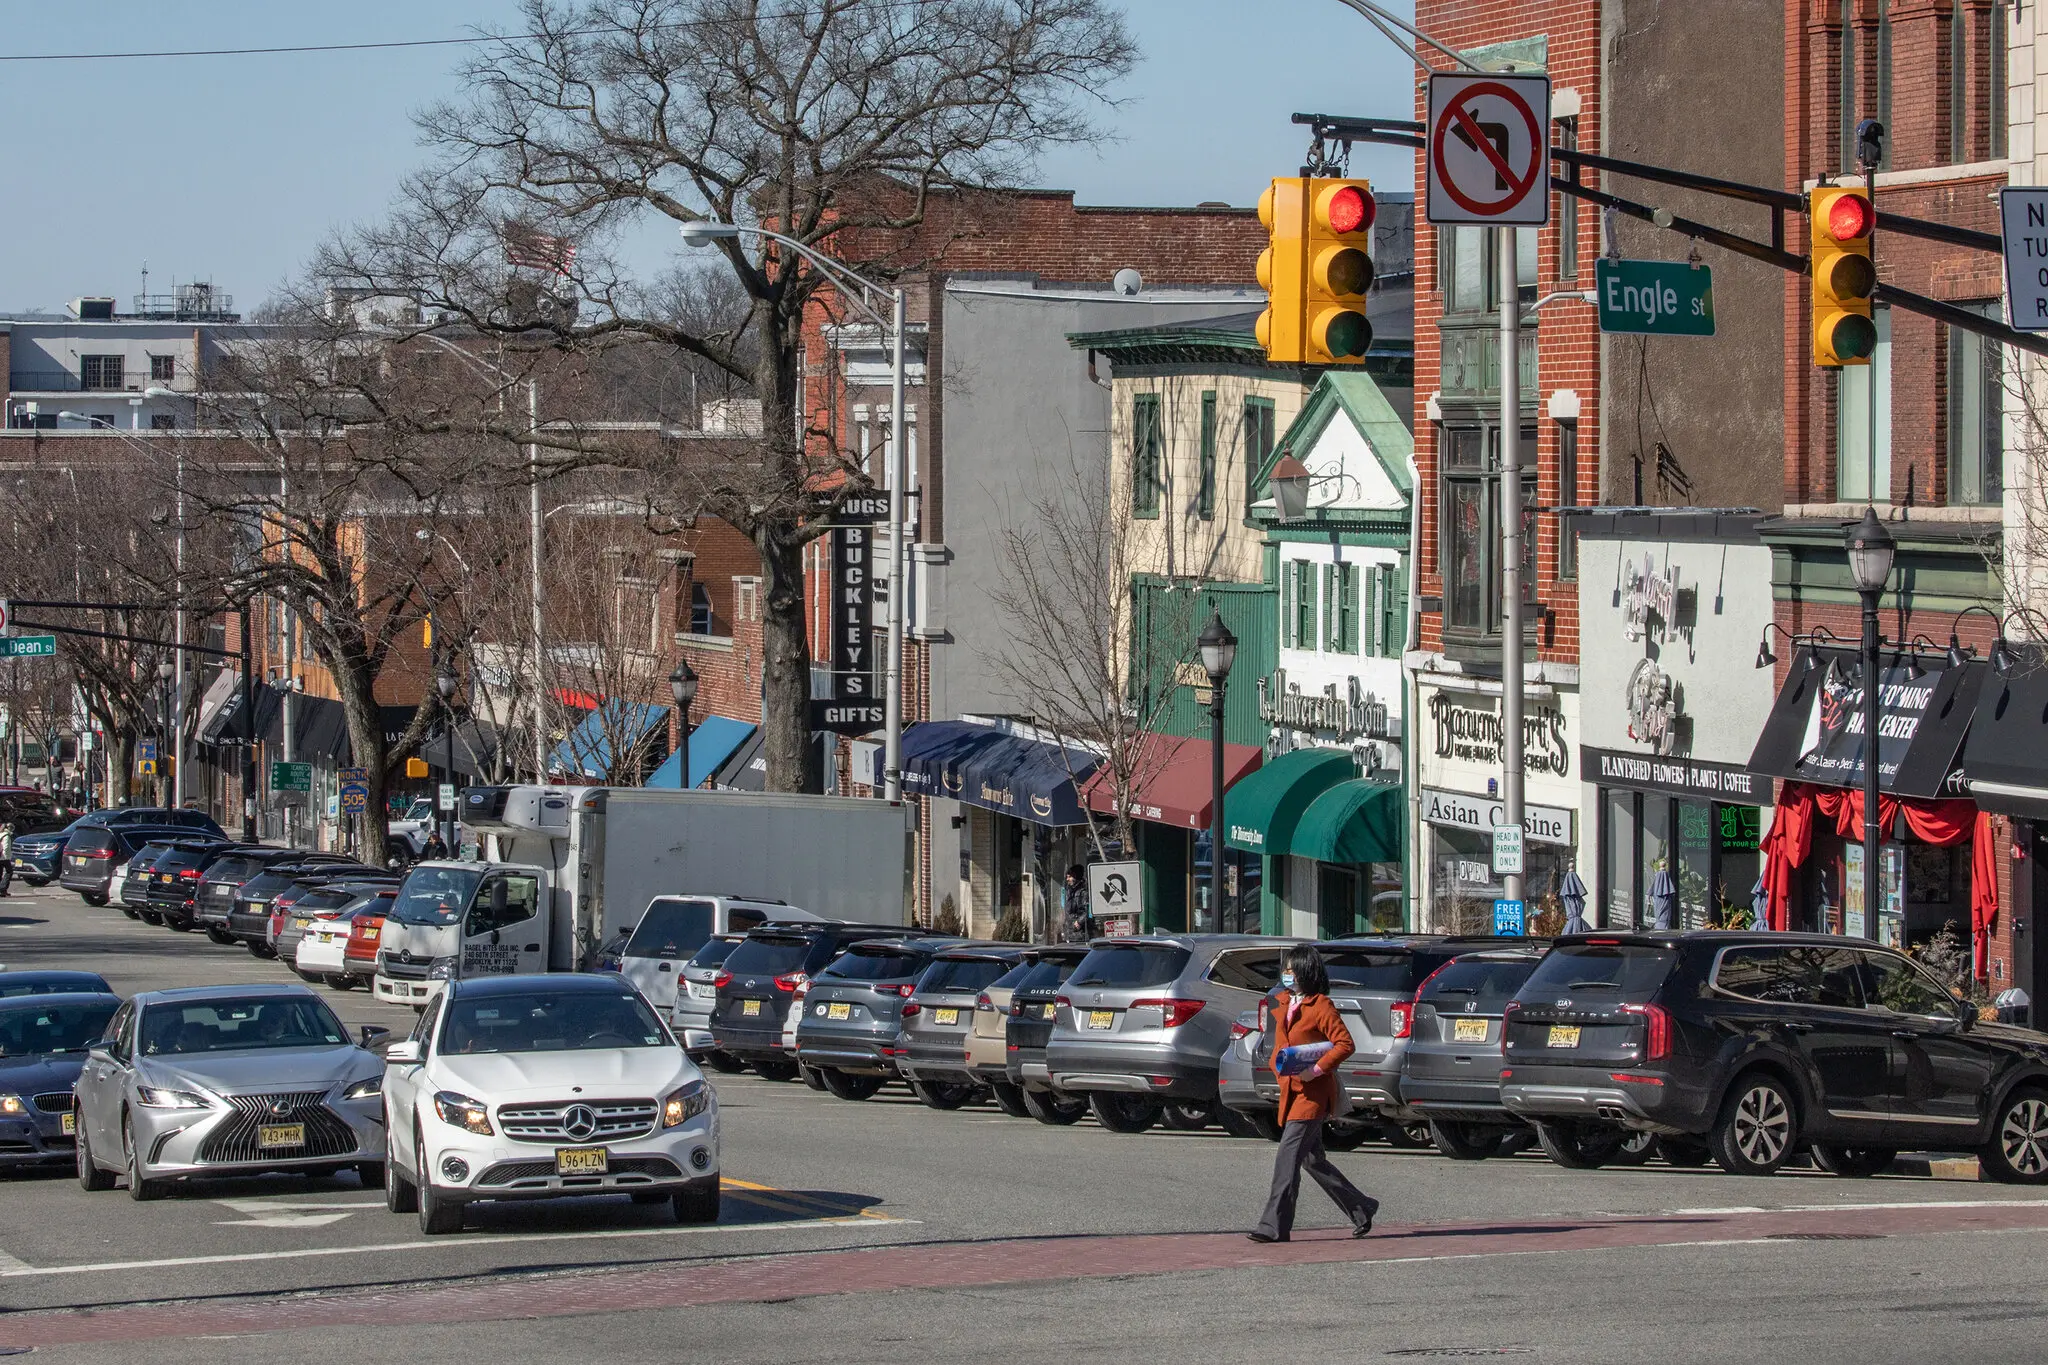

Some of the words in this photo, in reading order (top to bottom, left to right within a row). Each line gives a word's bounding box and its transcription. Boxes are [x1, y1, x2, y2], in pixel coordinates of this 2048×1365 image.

[2027, 203, 2046, 227] N
[2023, 237, 2048, 257] TU
[2038, 268, 2048, 287] O
[1605, 277, 1677, 324] Engle
[1691, 297, 1706, 317] St
[820, 499, 888, 515] UGS
[845, 528, 862, 693] BUCKLEY'S
[9, 641, 41, 653] Dean
[45, 645, 53, 653] St
[825, 707, 883, 722] GIFTS
[1273, 669, 1347, 743] University
[1347, 675, 1387, 736] Room
[1878, 714, 1918, 739] CENTER
[340, 771, 367, 779] NORTH
[1601, 755, 1651, 781] PLANTSHED
[1653, 763, 1684, 786] FLOWERS
[1692, 770, 1717, 791] PLANTS
[1725, 772, 1751, 794] COFFEE
[343, 794, 365, 806] 505
[1429, 796, 1480, 825] Asian
[1489, 806, 1562, 837] Csine
[1496, 832, 1512, 841] HEAD
[1513, 832, 1519, 841] IN
[1496, 844, 1520, 854] PARKING
[1499, 857, 1516, 866] ONLY
[1460, 861, 1488, 883] OPEN
[1496, 904, 1520, 914] FREE
[489, 951, 509, 959] STREET
